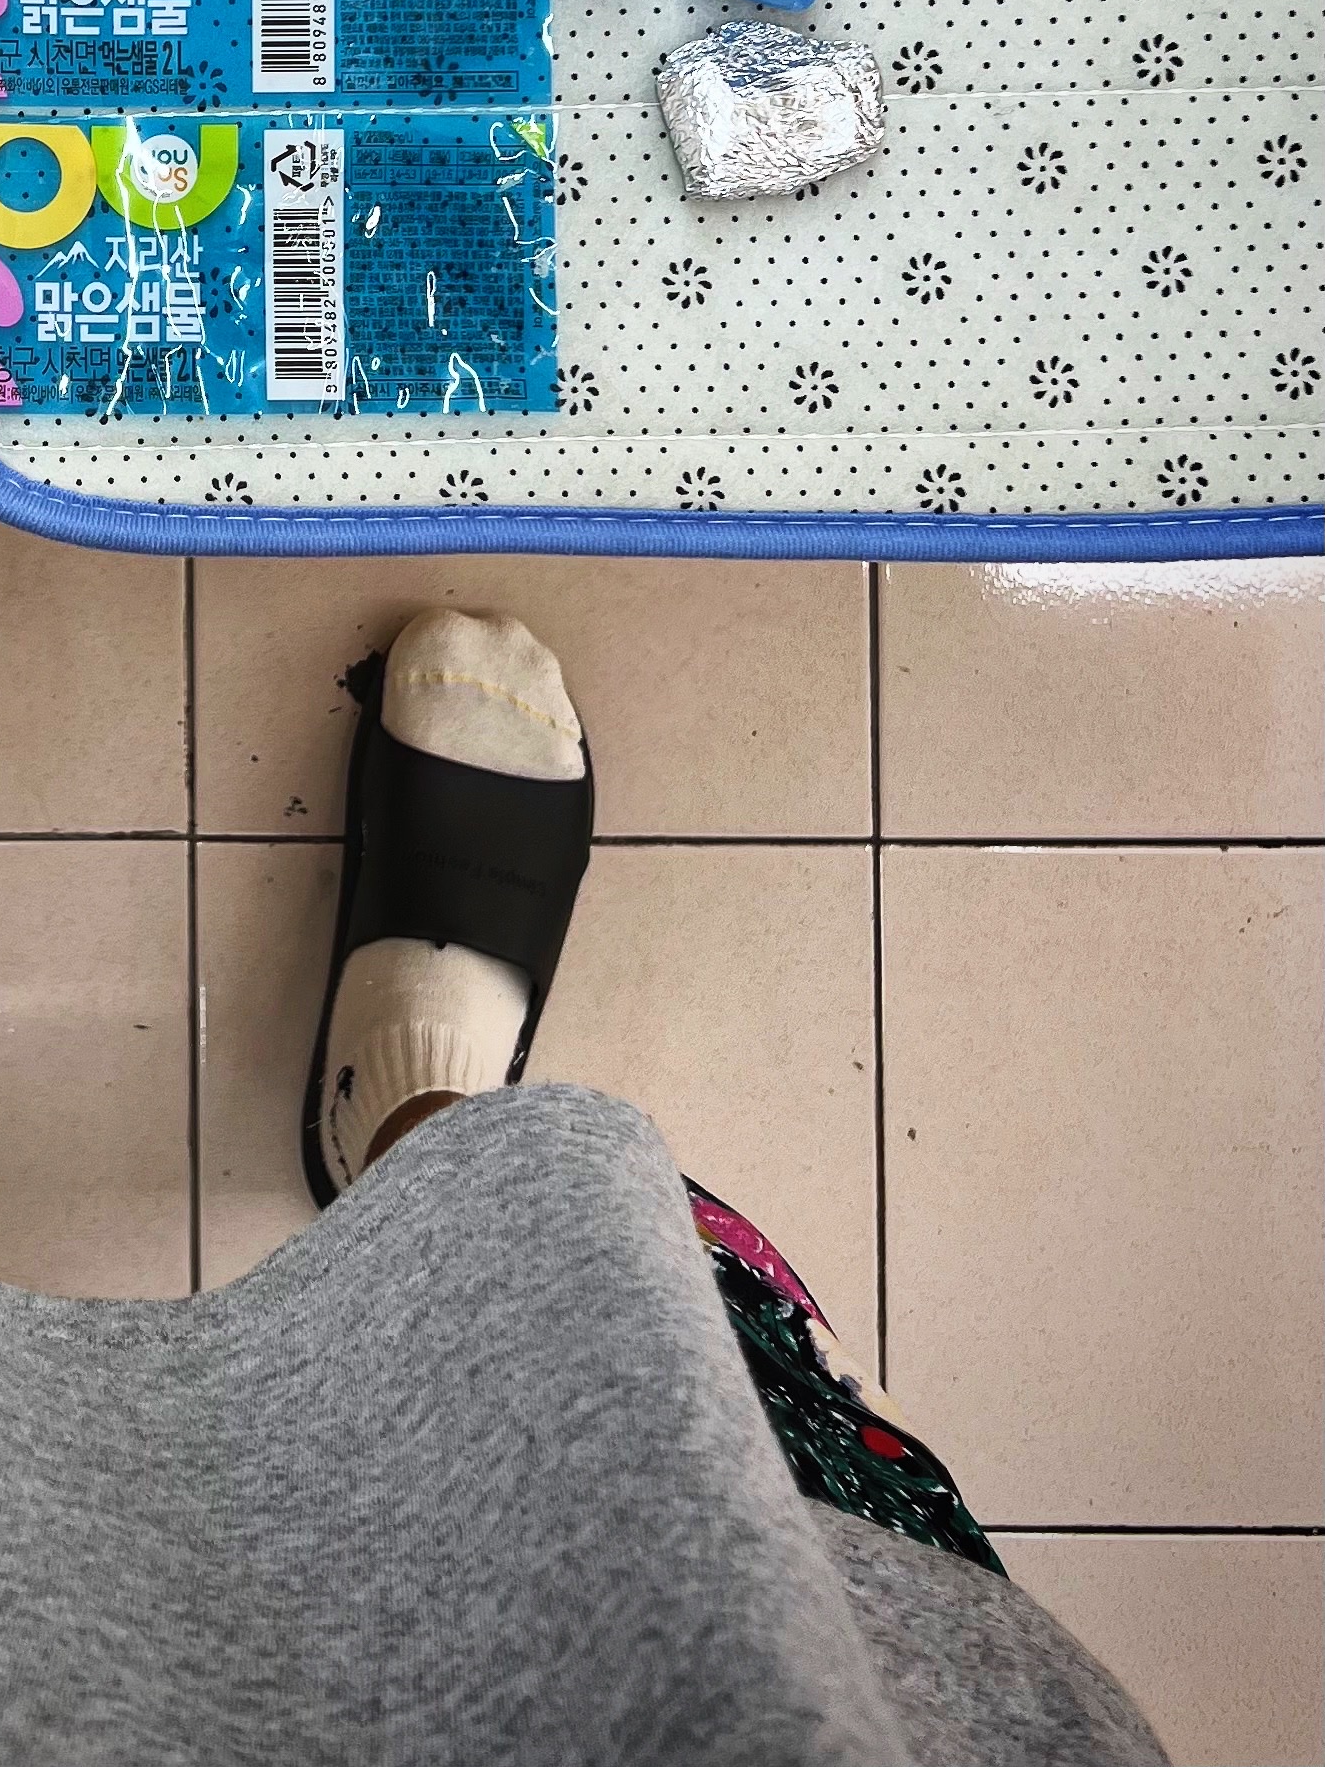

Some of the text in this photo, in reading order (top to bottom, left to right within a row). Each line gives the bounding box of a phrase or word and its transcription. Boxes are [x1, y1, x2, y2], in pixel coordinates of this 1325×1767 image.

[26, 40, 98, 75] 시천면
[101, 40, 159, 76] 먹는샘물
[104, 234, 205, 280] 지리산
[33, 280, 207, 343] 맑은샘물
[42, 346, 111, 383] 시천면
